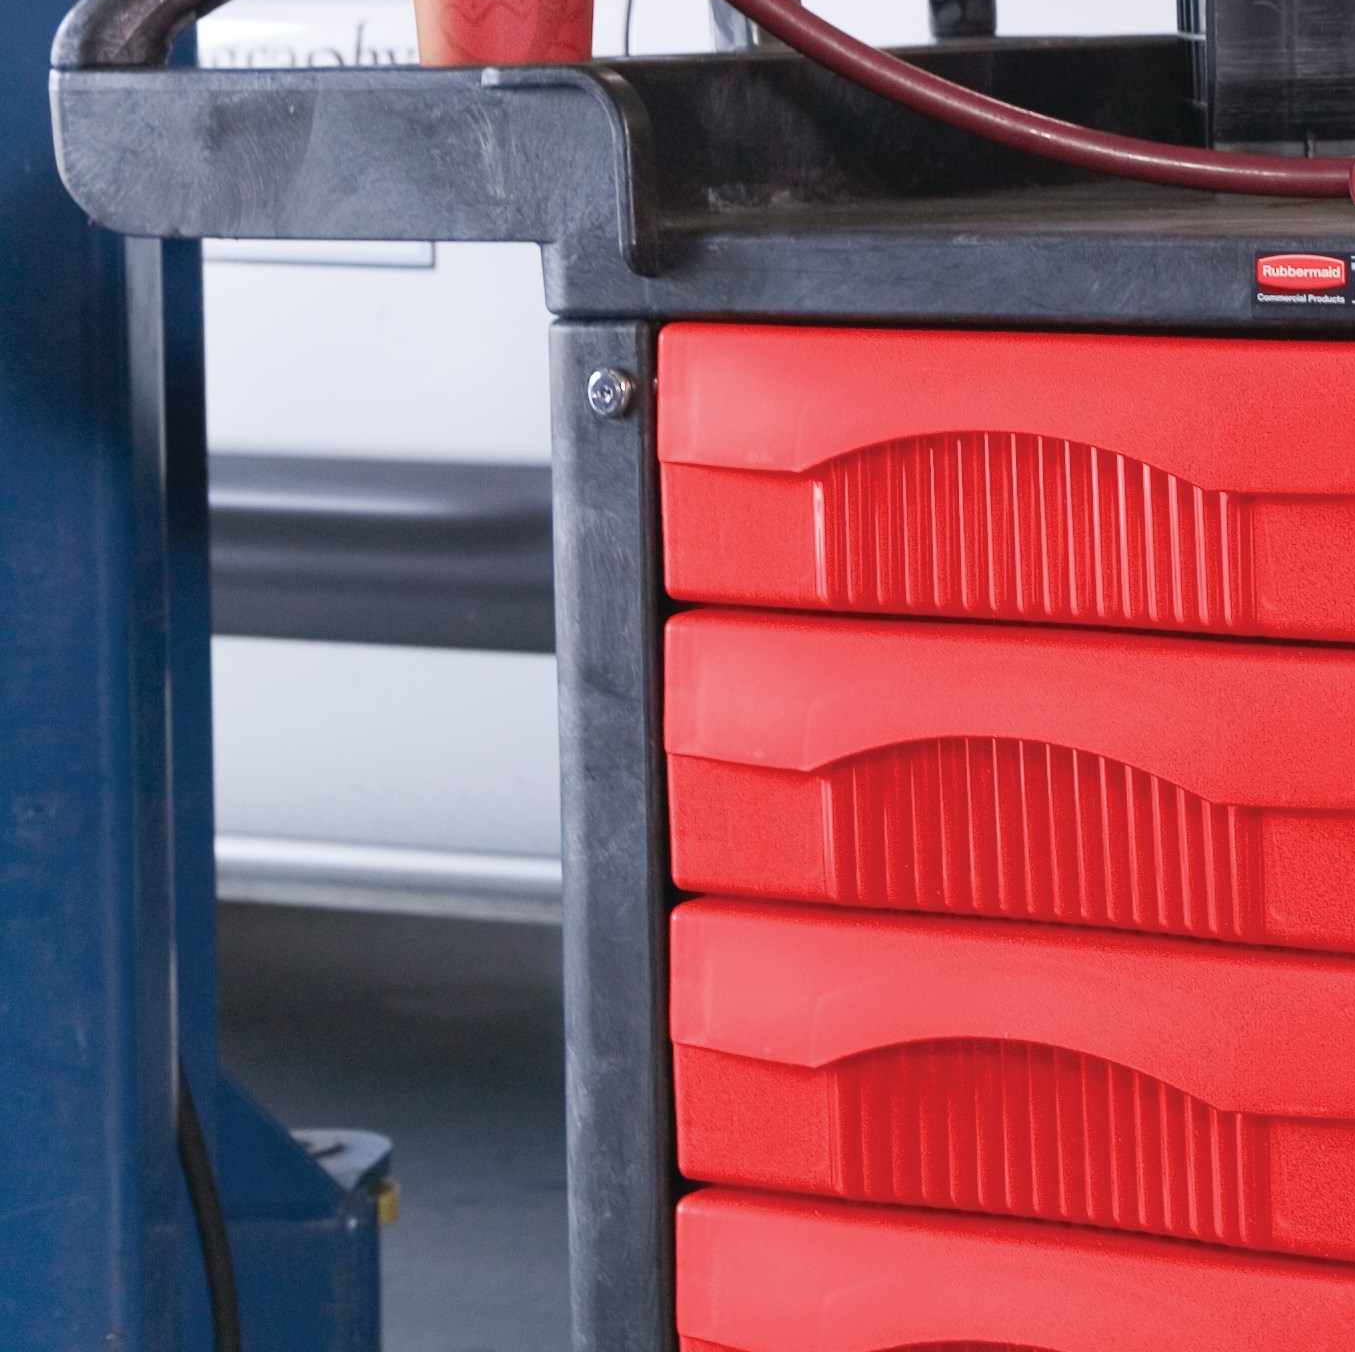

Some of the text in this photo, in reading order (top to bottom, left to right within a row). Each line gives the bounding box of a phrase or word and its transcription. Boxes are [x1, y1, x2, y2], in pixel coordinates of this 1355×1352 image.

[1262, 264, 1341, 278] Rubbermaid
[1257, 293, 1346, 304] Commercial Products
